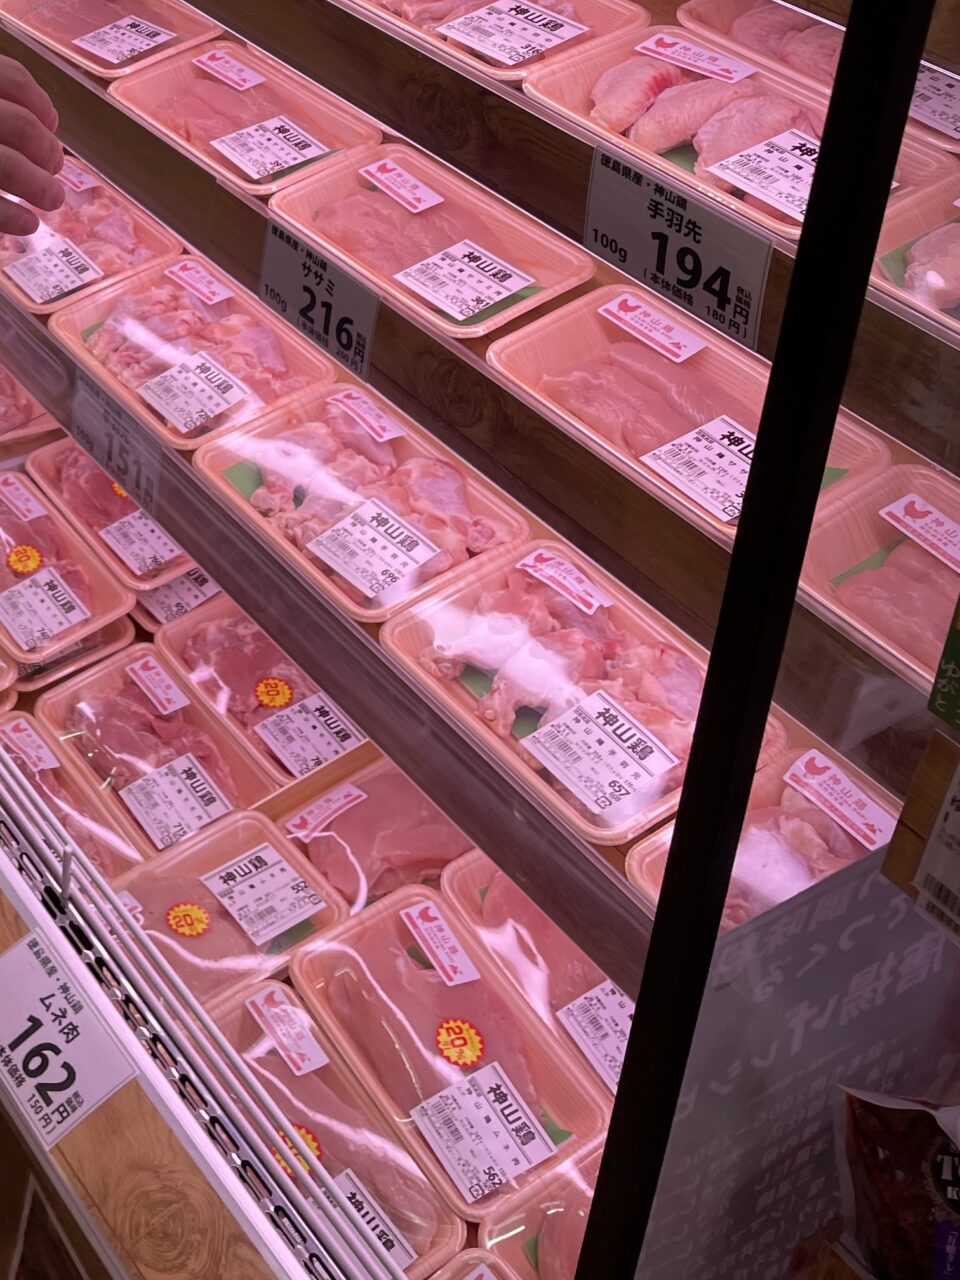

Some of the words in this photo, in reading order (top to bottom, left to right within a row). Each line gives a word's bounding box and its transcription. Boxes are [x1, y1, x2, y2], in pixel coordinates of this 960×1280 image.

[508, 4, 565, 32] 神山鶏
[271, 123, 312, 151] 神山鶏
[790, 142, 819, 162] 神
[600, 154, 688, 211] 徳島県産・神山鶏
[647, 198, 703, 244] 手羽先
[59, 247, 90, 276] 神山鶏
[592, 228, 627, 263] 100g
[301, 261, 335, 297] ササミ
[461, 250, 513, 283] 神山鶏
[651, 231, 732, 312] 194
[264, 283, 287, 313] 100g
[298, 285, 354, 352] 216
[732, 304, 750, 326] 円
[193, 361, 235, 395] 神山鶏
[720, 431, 756, 462] 神山
[370, 511, 420, 553] 神山鶏
[187, 568, 209, 588] 山鶏
[43, 579, 78, 615] 神山鶏
[263, 681, 280, 697] 20
[314, 704, 353, 744] 神山鶏
[595, 707, 655, 762] 神山鶏
[180, 765, 218, 808] 神山鶏
[608, 780, 631, 797] 657
[828, 773, 868, 811] 神山鶏
[218, 855, 270, 887] 神山鶏
[173, 913, 195, 928] 20
[39, 993, 81, 1044] ムネ肉
[8, 1014, 76, 1108] 162
[50, 1103, 71, 1125] 円
[487, 1082, 536, 1147] 神山鶏
[483, 1166, 503, 1188] 562
[937, 1154, 960, 1181] T
